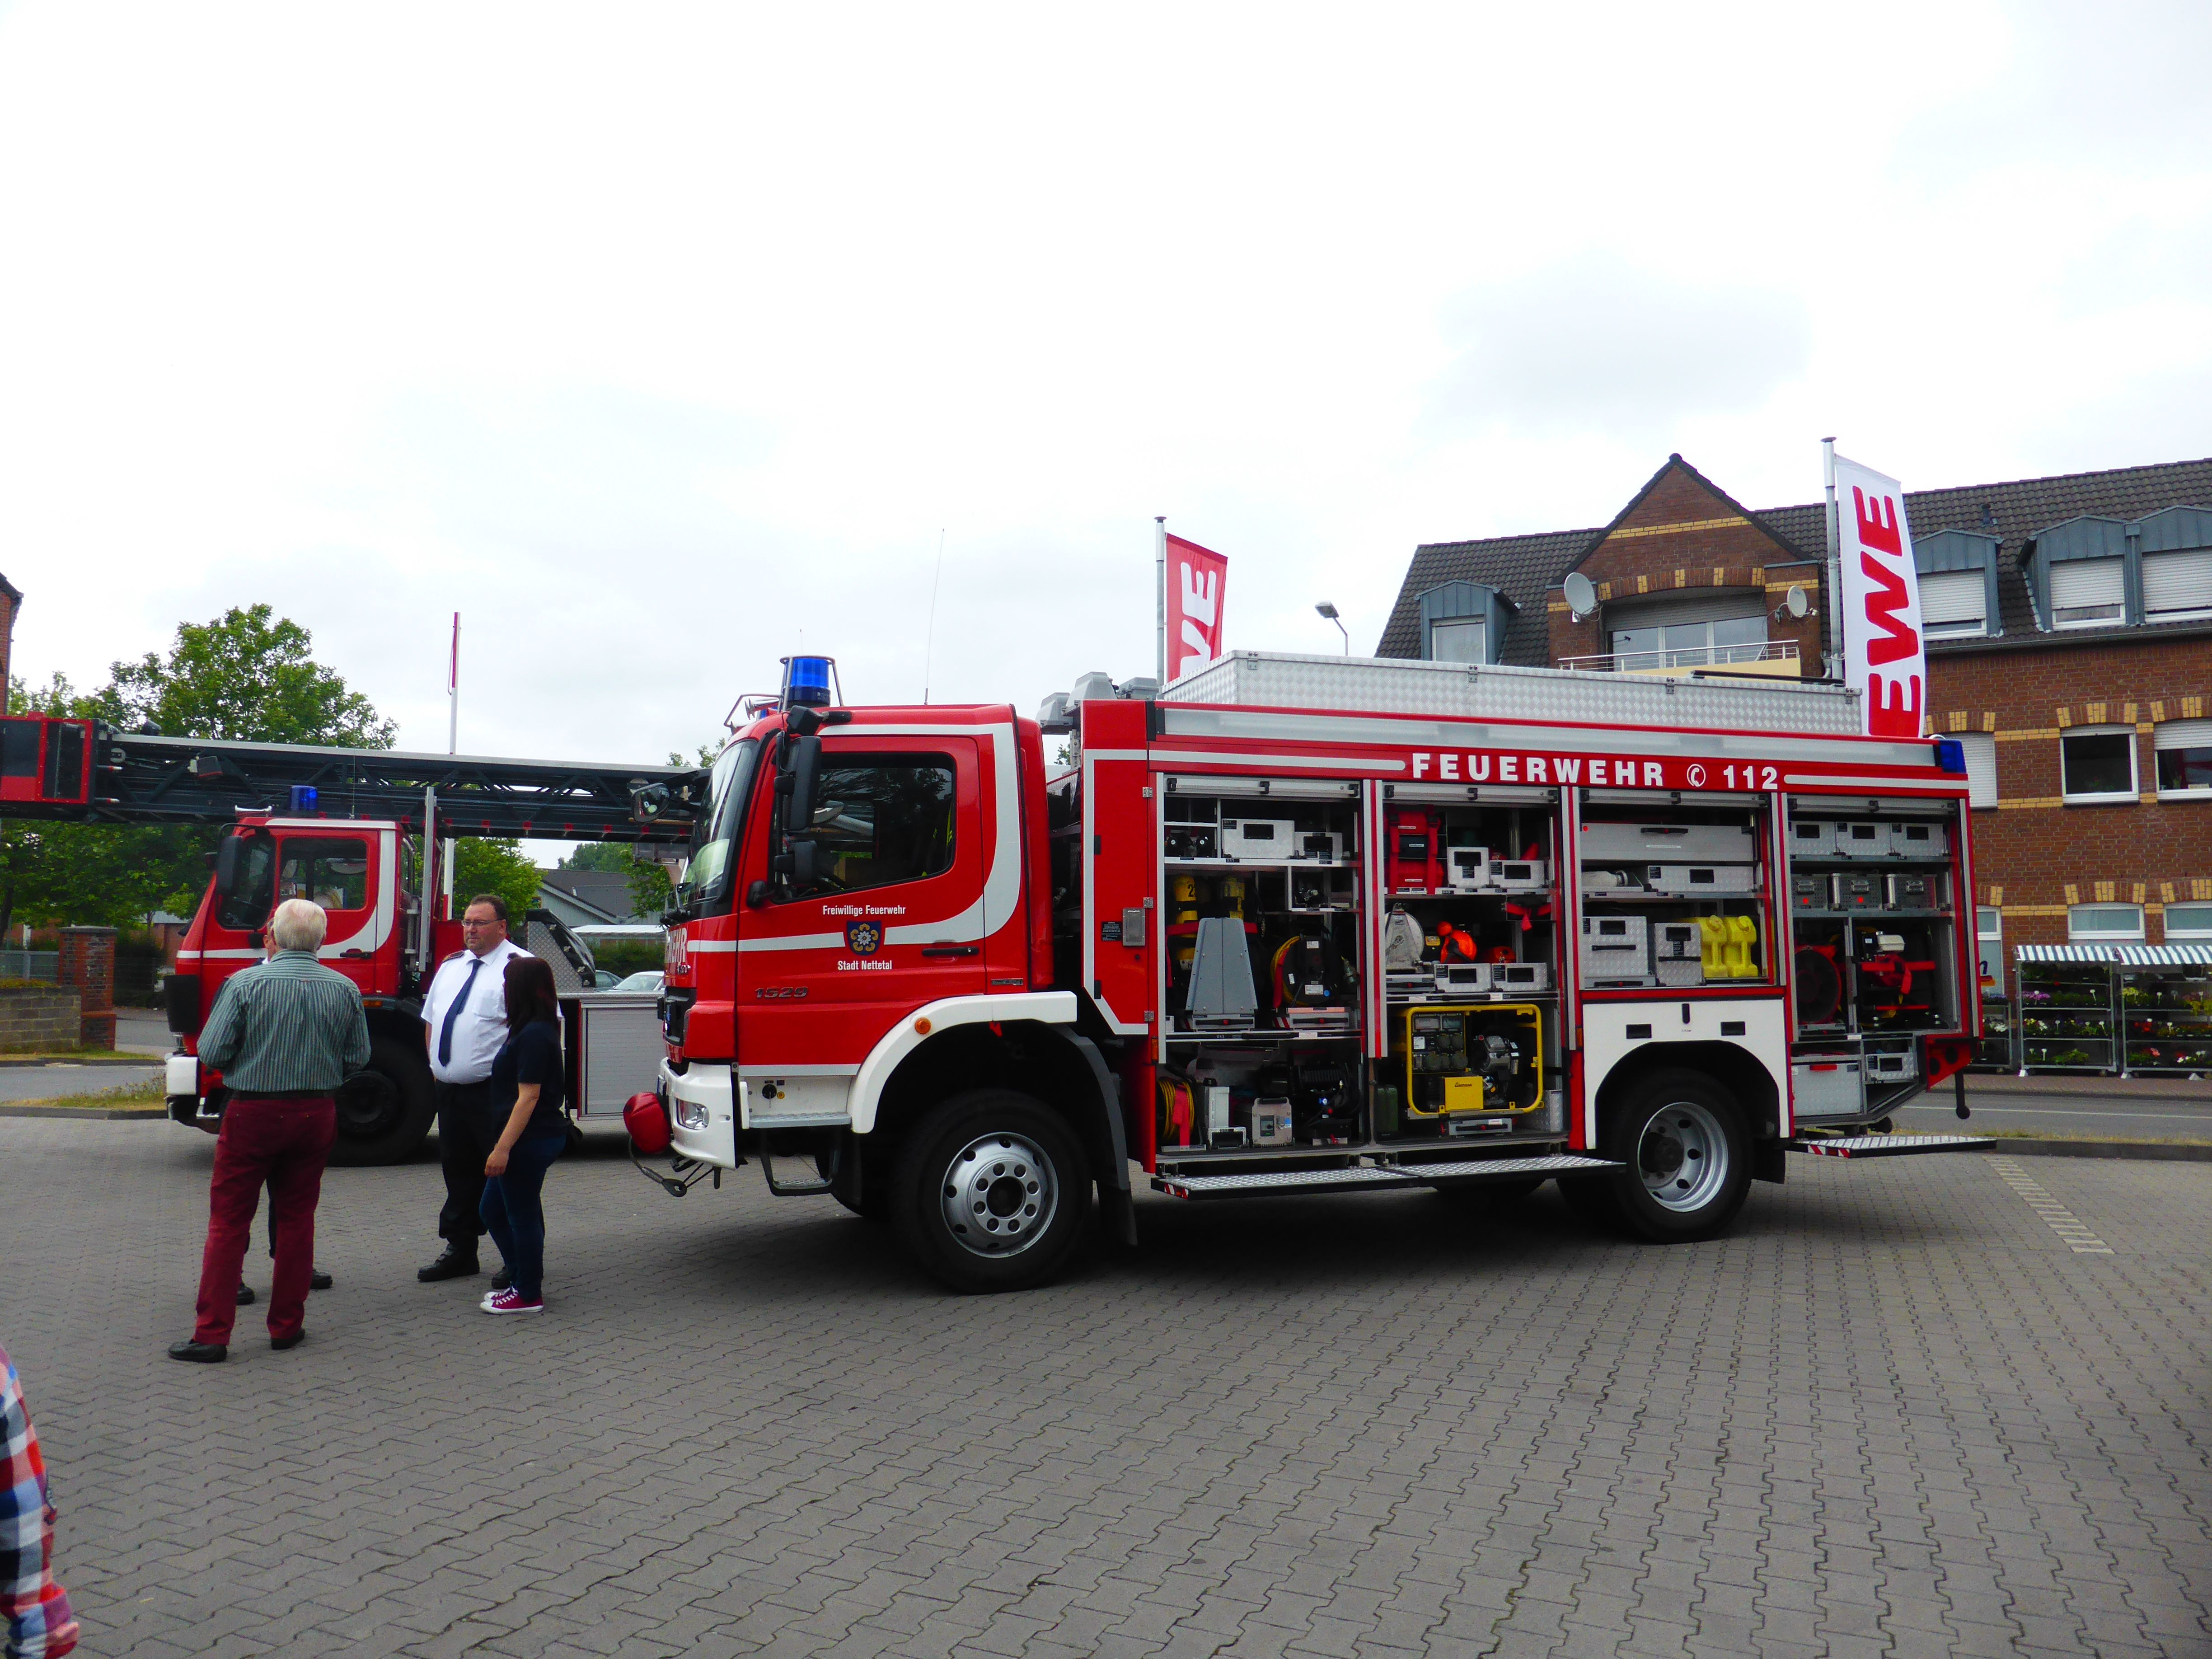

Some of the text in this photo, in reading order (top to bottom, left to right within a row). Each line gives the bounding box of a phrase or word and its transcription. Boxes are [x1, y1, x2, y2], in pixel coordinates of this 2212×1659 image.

[1852, 485, 1921, 737] EWE
[1412, 753, 1778, 790] FEUERWEHR 112
[823, 904, 906, 917] Freiwillige Feuerwehr
[838, 960, 892, 970] Stadt Nettetal
[755, 986, 808, 998] 1529
